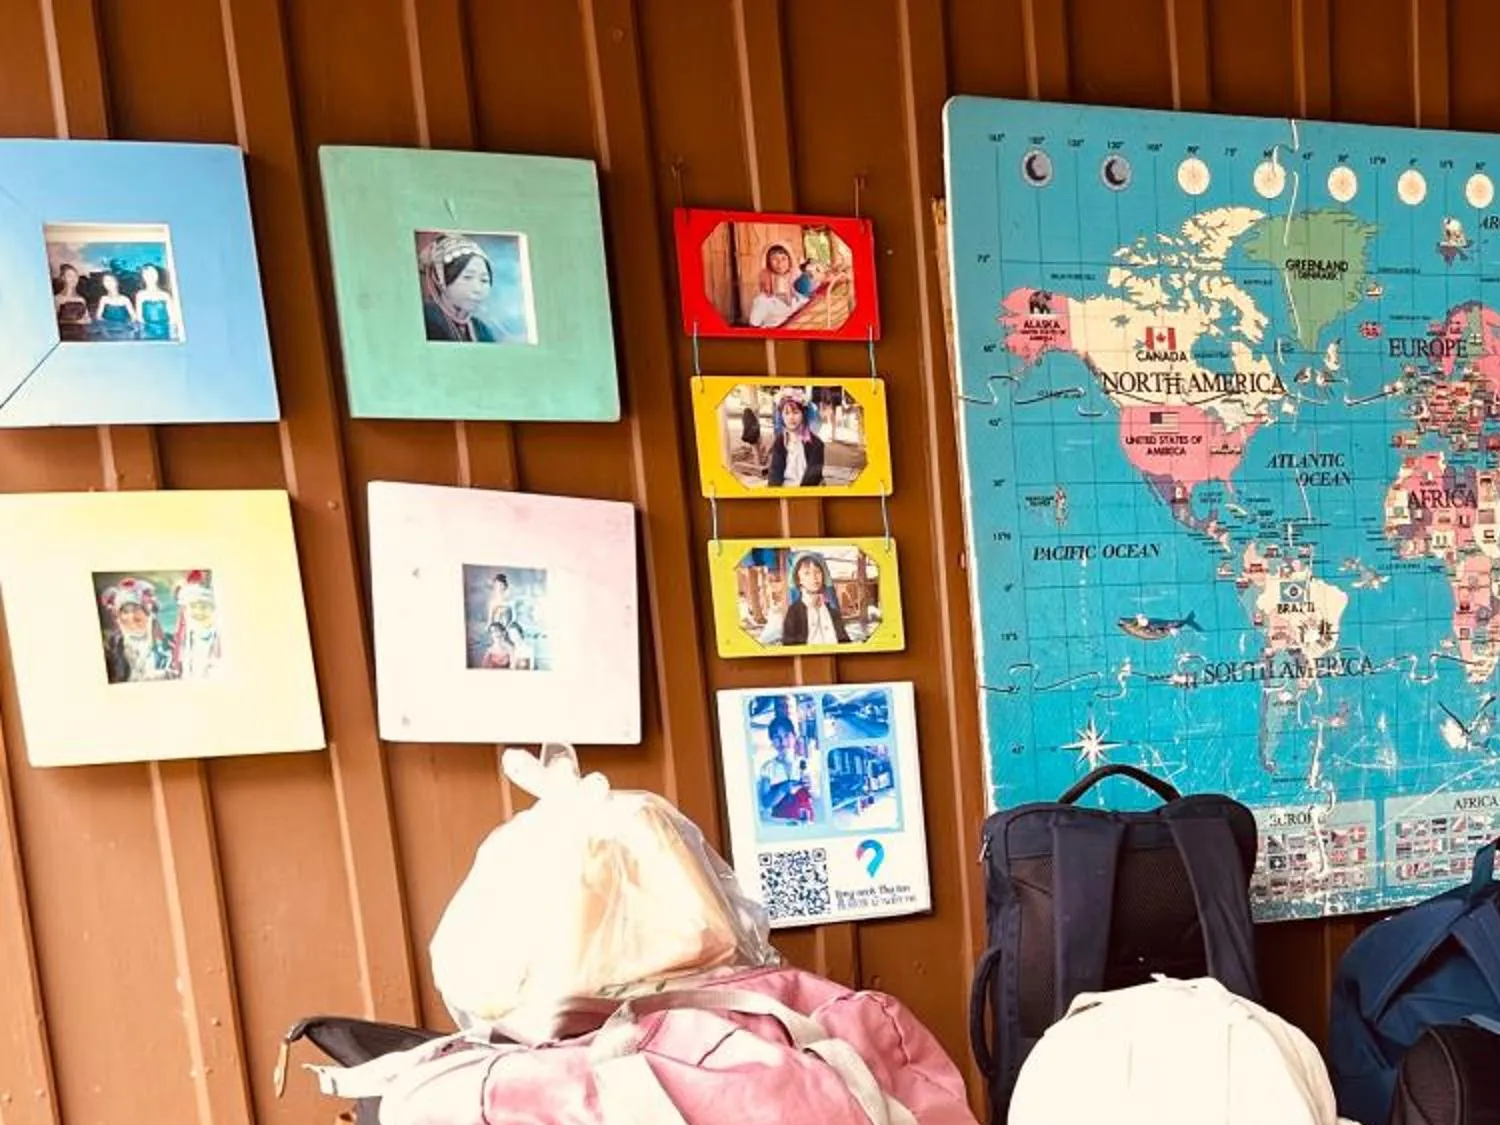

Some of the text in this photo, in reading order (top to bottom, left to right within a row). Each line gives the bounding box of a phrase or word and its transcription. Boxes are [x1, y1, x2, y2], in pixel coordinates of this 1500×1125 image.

[1023, 319, 1060, 329] ALASKA
[1388, 337, 1469, 358] EUROPE
[1136, 351, 1188, 362] CANADA
[1100, 371, 1286, 394] NORTH AMERICA
[1264, 453, 1345, 468] ATLANTIC
[1296, 471, 1351, 487] OCEAN
[1408, 488, 1478, 509] AFRICA
[1033, 543, 1161, 561] PACIFIC OCEAN
[1453, 796, 1500, 811] AFRICA
